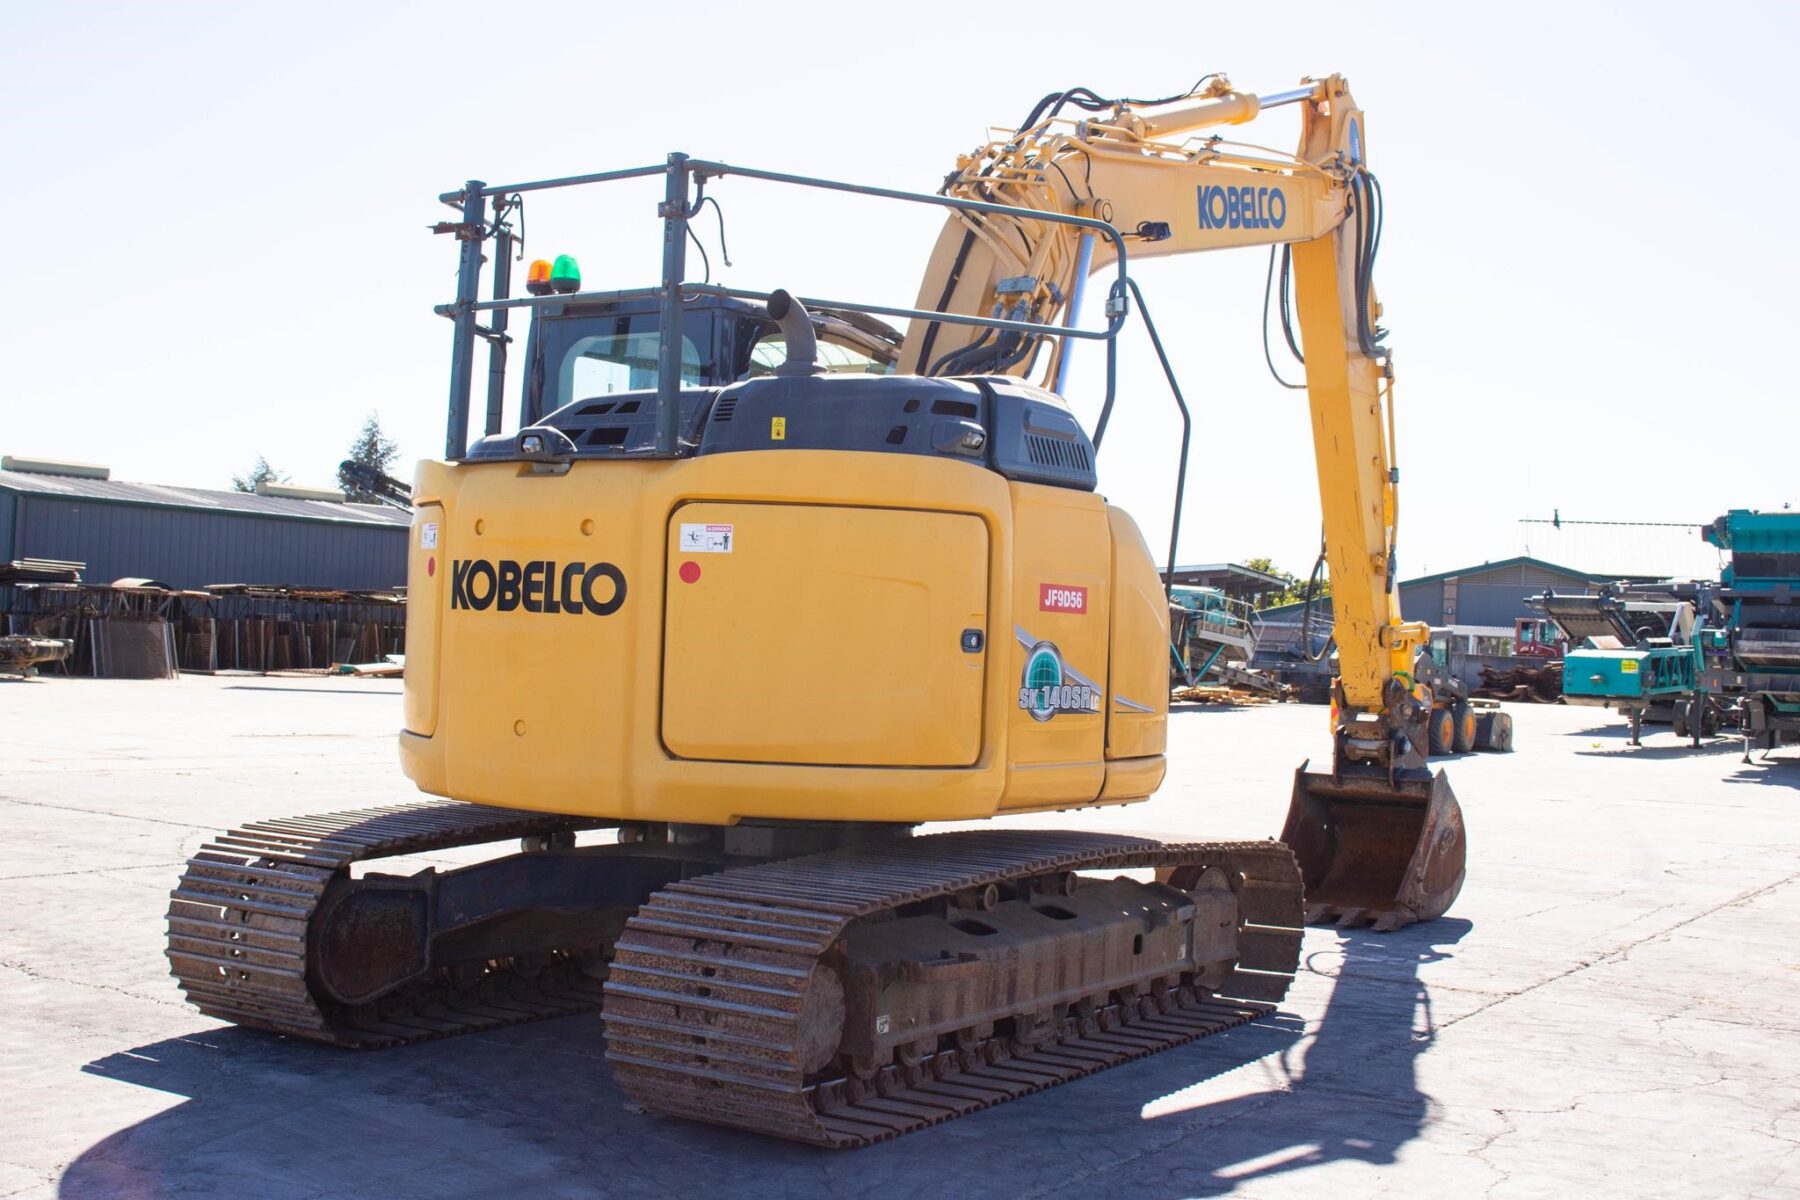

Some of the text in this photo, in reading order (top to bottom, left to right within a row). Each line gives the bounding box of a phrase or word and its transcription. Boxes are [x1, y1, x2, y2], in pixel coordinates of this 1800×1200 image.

[1197, 185, 1286, 229] KOBELCO
[451, 559, 628, 616] KOBELCO
[1044, 589, 1083, 608] JF9D56
[1018, 688, 1039, 709] SK
